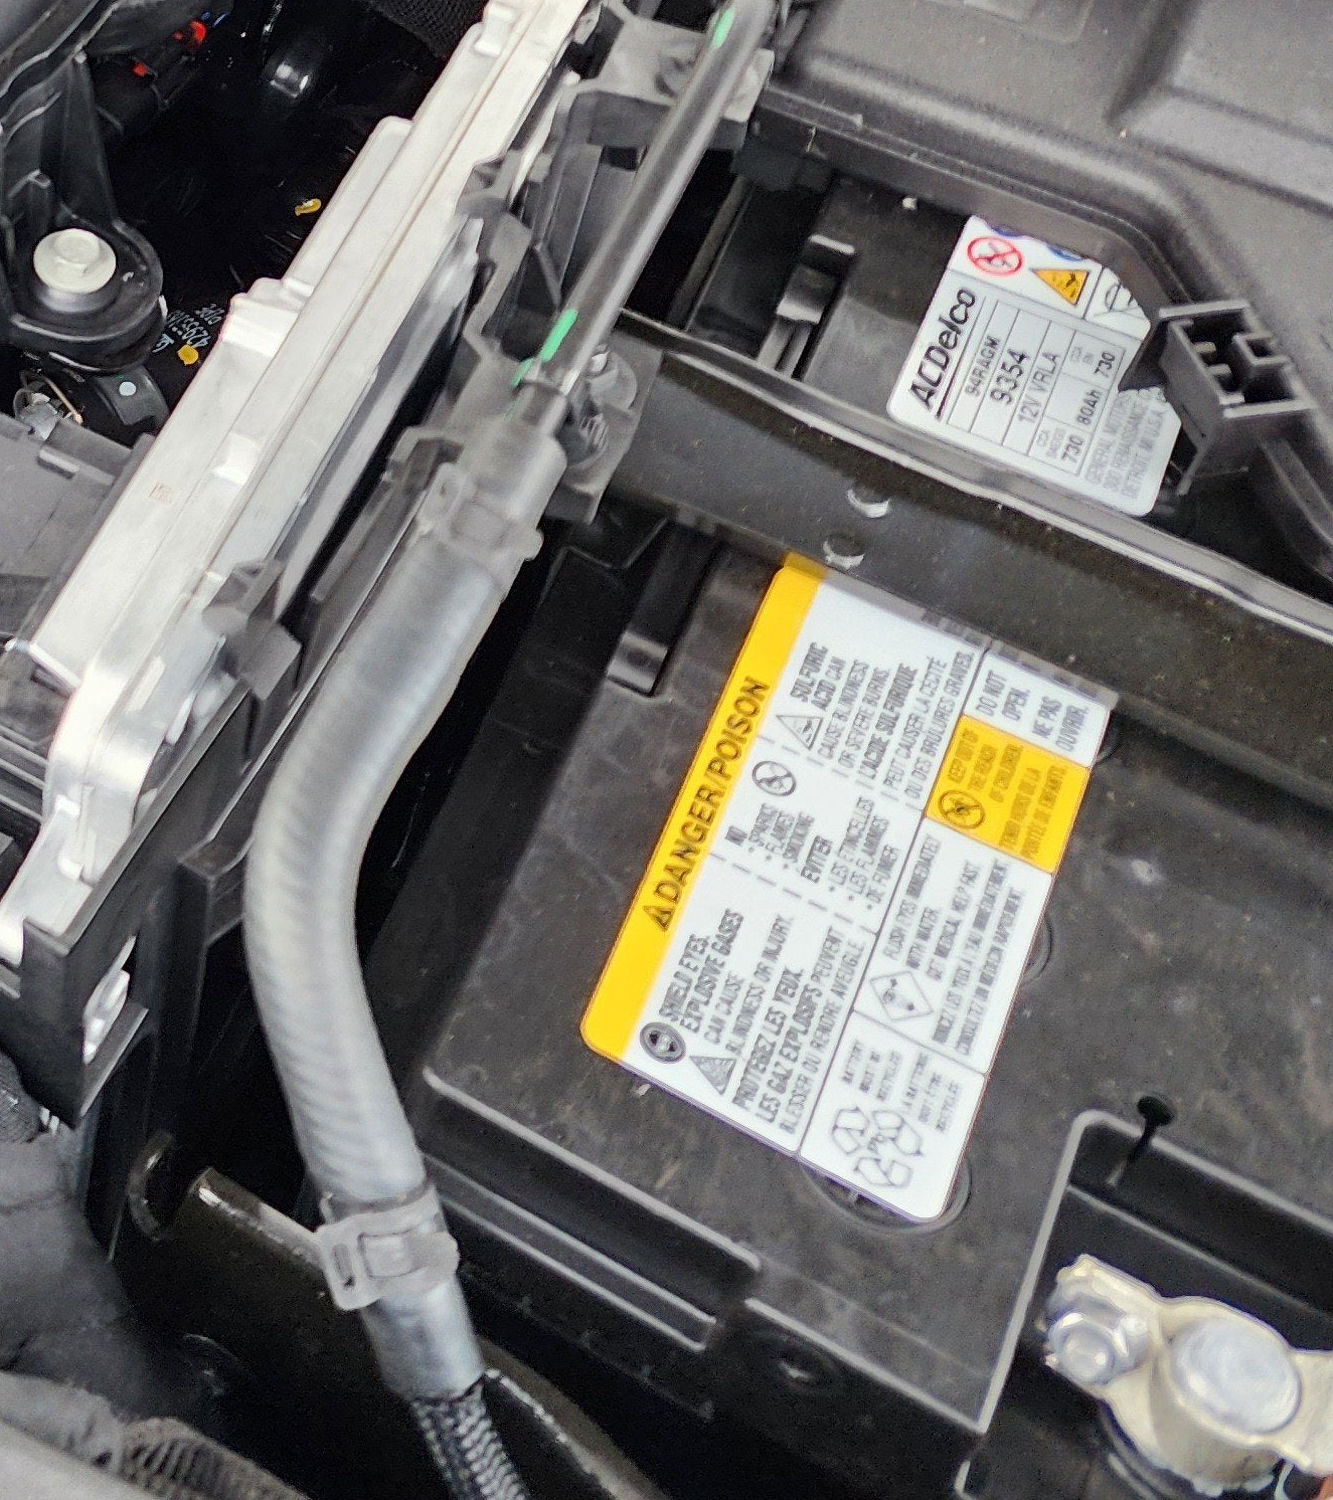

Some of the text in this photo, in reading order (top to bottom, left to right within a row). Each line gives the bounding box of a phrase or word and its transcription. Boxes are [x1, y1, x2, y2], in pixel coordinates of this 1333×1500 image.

[905, 284, 977, 409] ACDelco
[964, 334, 1000, 397] 94RAGM
[1094, 350, 1116, 378] 730
[988, 347, 1029, 406] 9354
[1017, 348, 1060, 425] 12V VRLA
[1075, 387, 1102, 426] 80Ah
[1061, 434, 1084, 464] 730
[1084, 390, 1131, 485] GENERAL MOTORS
[788, 640, 830, 703] SULFURIC
[809, 653, 847, 712] ACID CAN
[976, 669, 1007, 717] DO NOT
[815, 658, 870, 760] CAUSE BLINDNESS
[873, 661, 918, 736] SULFURIQUE
[911, 694, 932, 714] LA
[1032, 695, 1062, 739] NE PAS
[843, 706, 875, 752] SEVERE
[893, 712, 925, 760] CAUSER
[836, 748, 858, 769] OR
[881, 757, 907, 790] PEUT
[910, 756, 933, 781] DES
[651, 673, 771, 906] DANGER/POISON
[903, 779, 924, 800] OU
[763, 809, 796, 855] FLAMES
[827, 860, 850, 886] LES
[845, 870, 868, 896] LES
[865, 842, 901, 905] DE FUMER
[678, 908, 744, 1033] EXPLOSIVE GASES
[809, 925, 847, 986] PEUVENT
[657, 969, 694, 1023] SHIELD
[701, 969, 746, 1045] CAN CAUSE
[722, 981, 767, 1058] BLINDNESS
[752, 961, 775, 984] OR
[760, 1005, 787, 1036] LES
[807, 997, 842, 1052] RENDRE
[766, 1060, 794, 1094] GAZ
[798, 1051, 822, 1074] OU
[754, 1092, 782, 1124] LES
